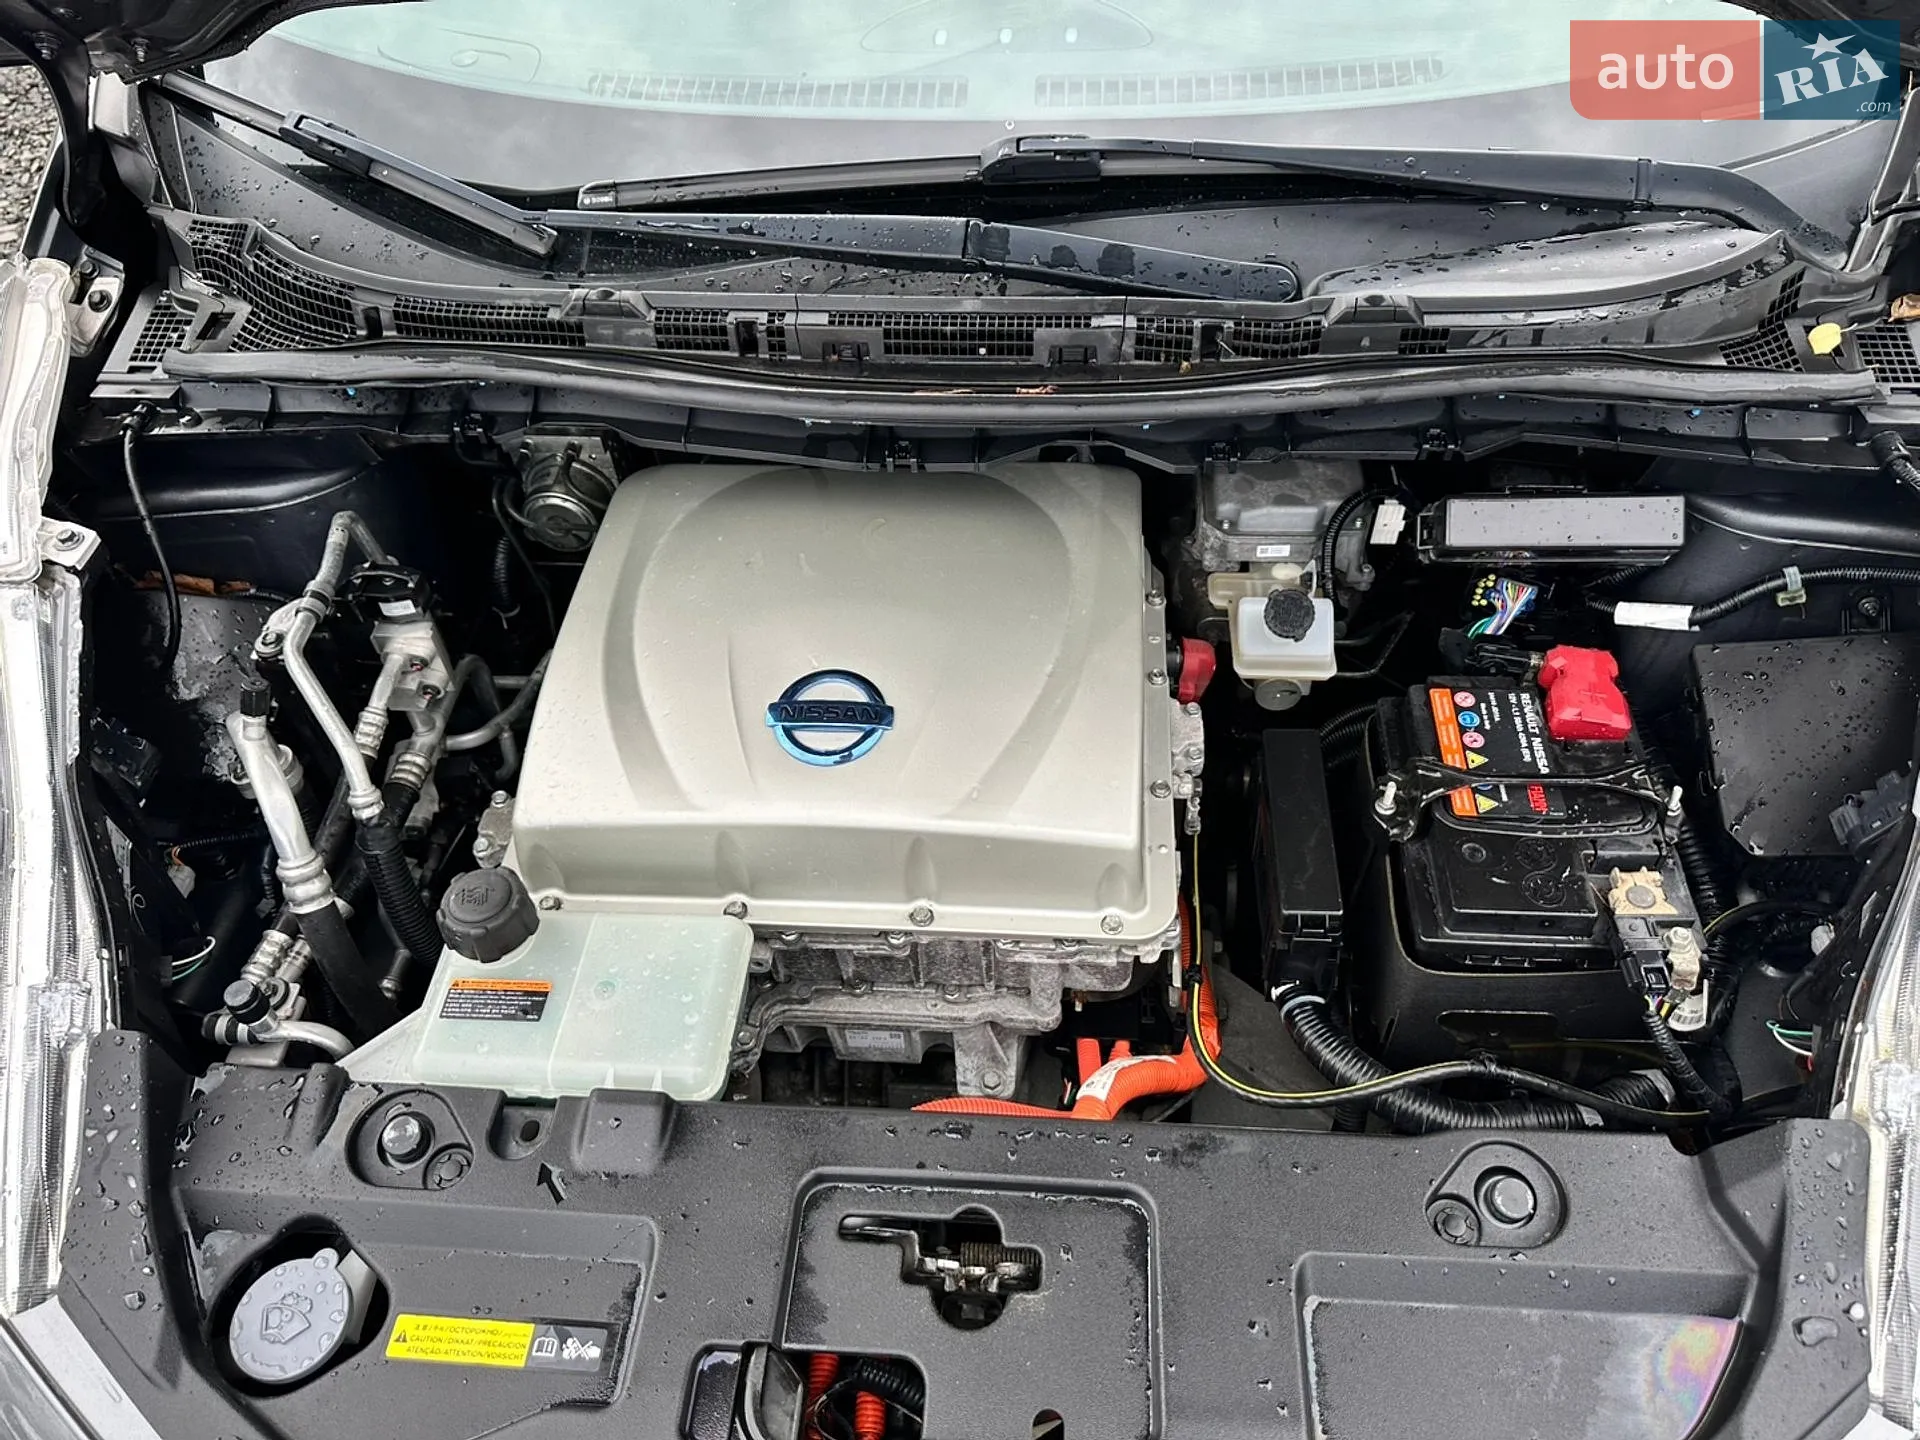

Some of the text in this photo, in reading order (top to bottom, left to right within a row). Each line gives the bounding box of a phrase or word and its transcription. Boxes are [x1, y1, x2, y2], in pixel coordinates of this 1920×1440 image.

[780, 704, 880, 722] NISSAN
[1520, 693, 1550, 774] RENAULT NISSA
